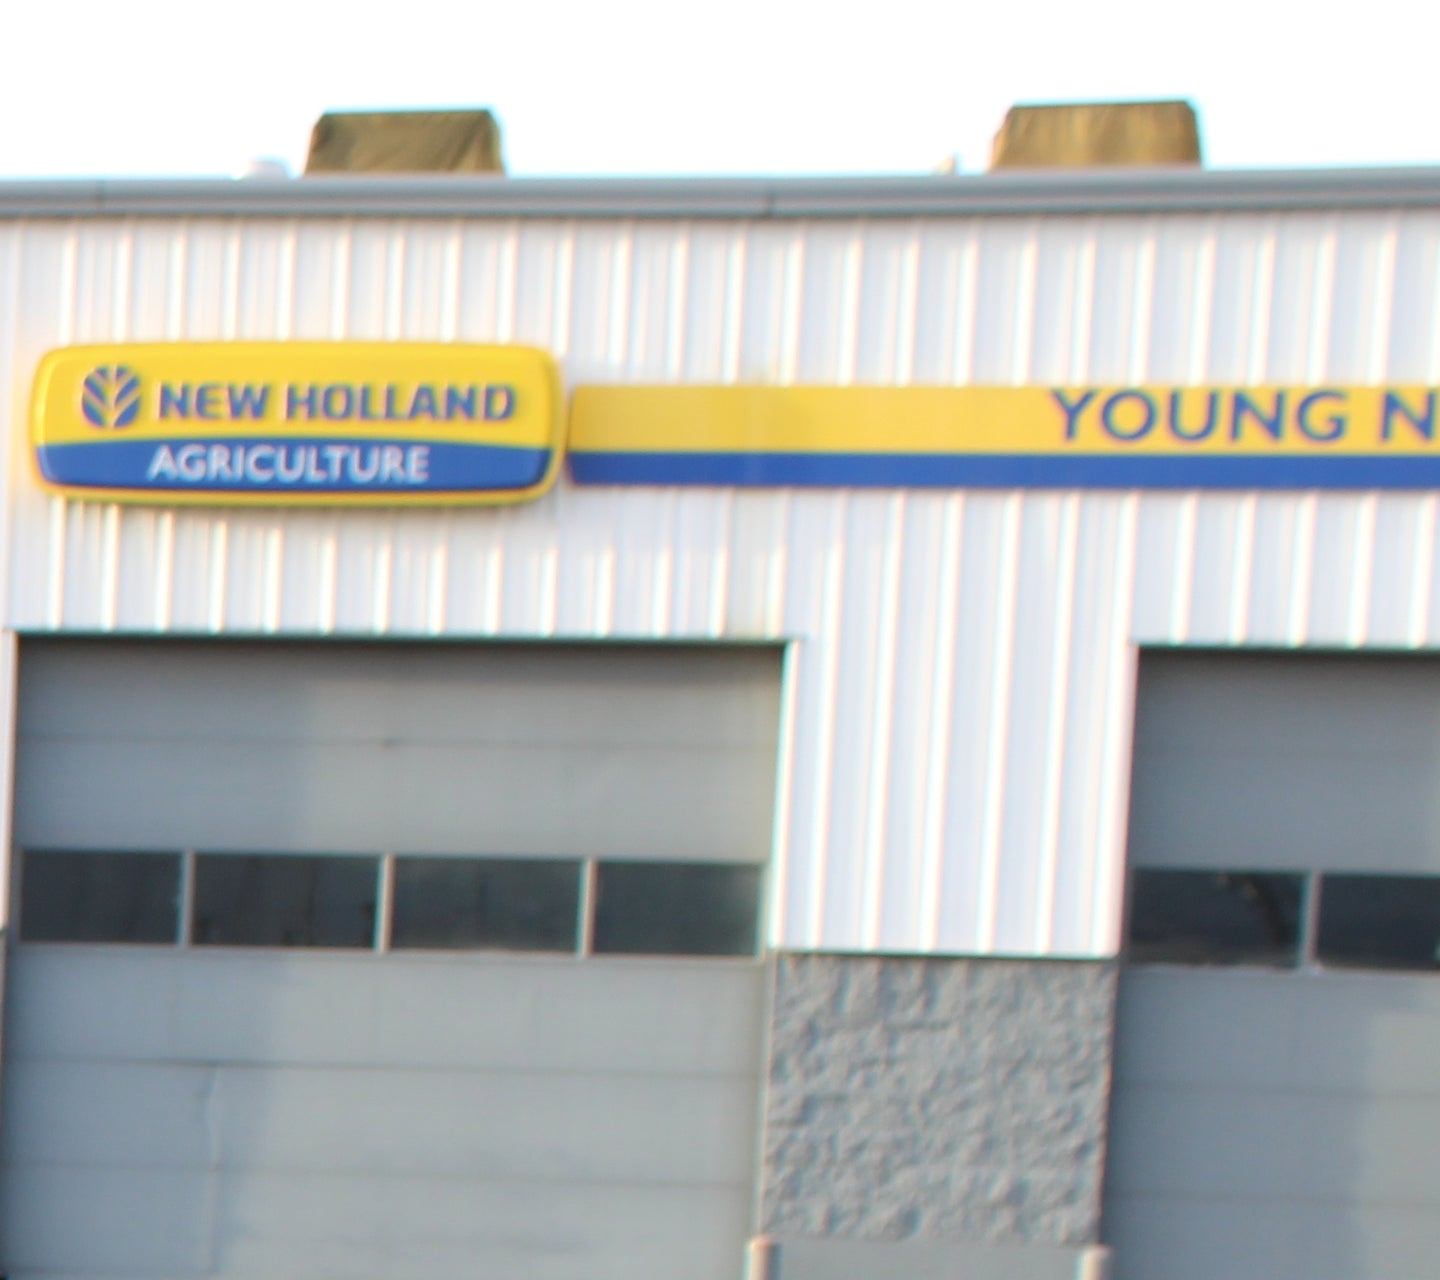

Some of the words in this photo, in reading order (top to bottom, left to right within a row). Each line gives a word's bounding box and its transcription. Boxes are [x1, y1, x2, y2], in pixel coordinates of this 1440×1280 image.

[158, 382, 270, 422] NEW
[285, 383, 516, 422] HOLLAND
[1052, 389, 1348, 442] YOUNG
[1381, 390, 1438, 441] N
[148, 445, 430, 483] AGRICULTURE
